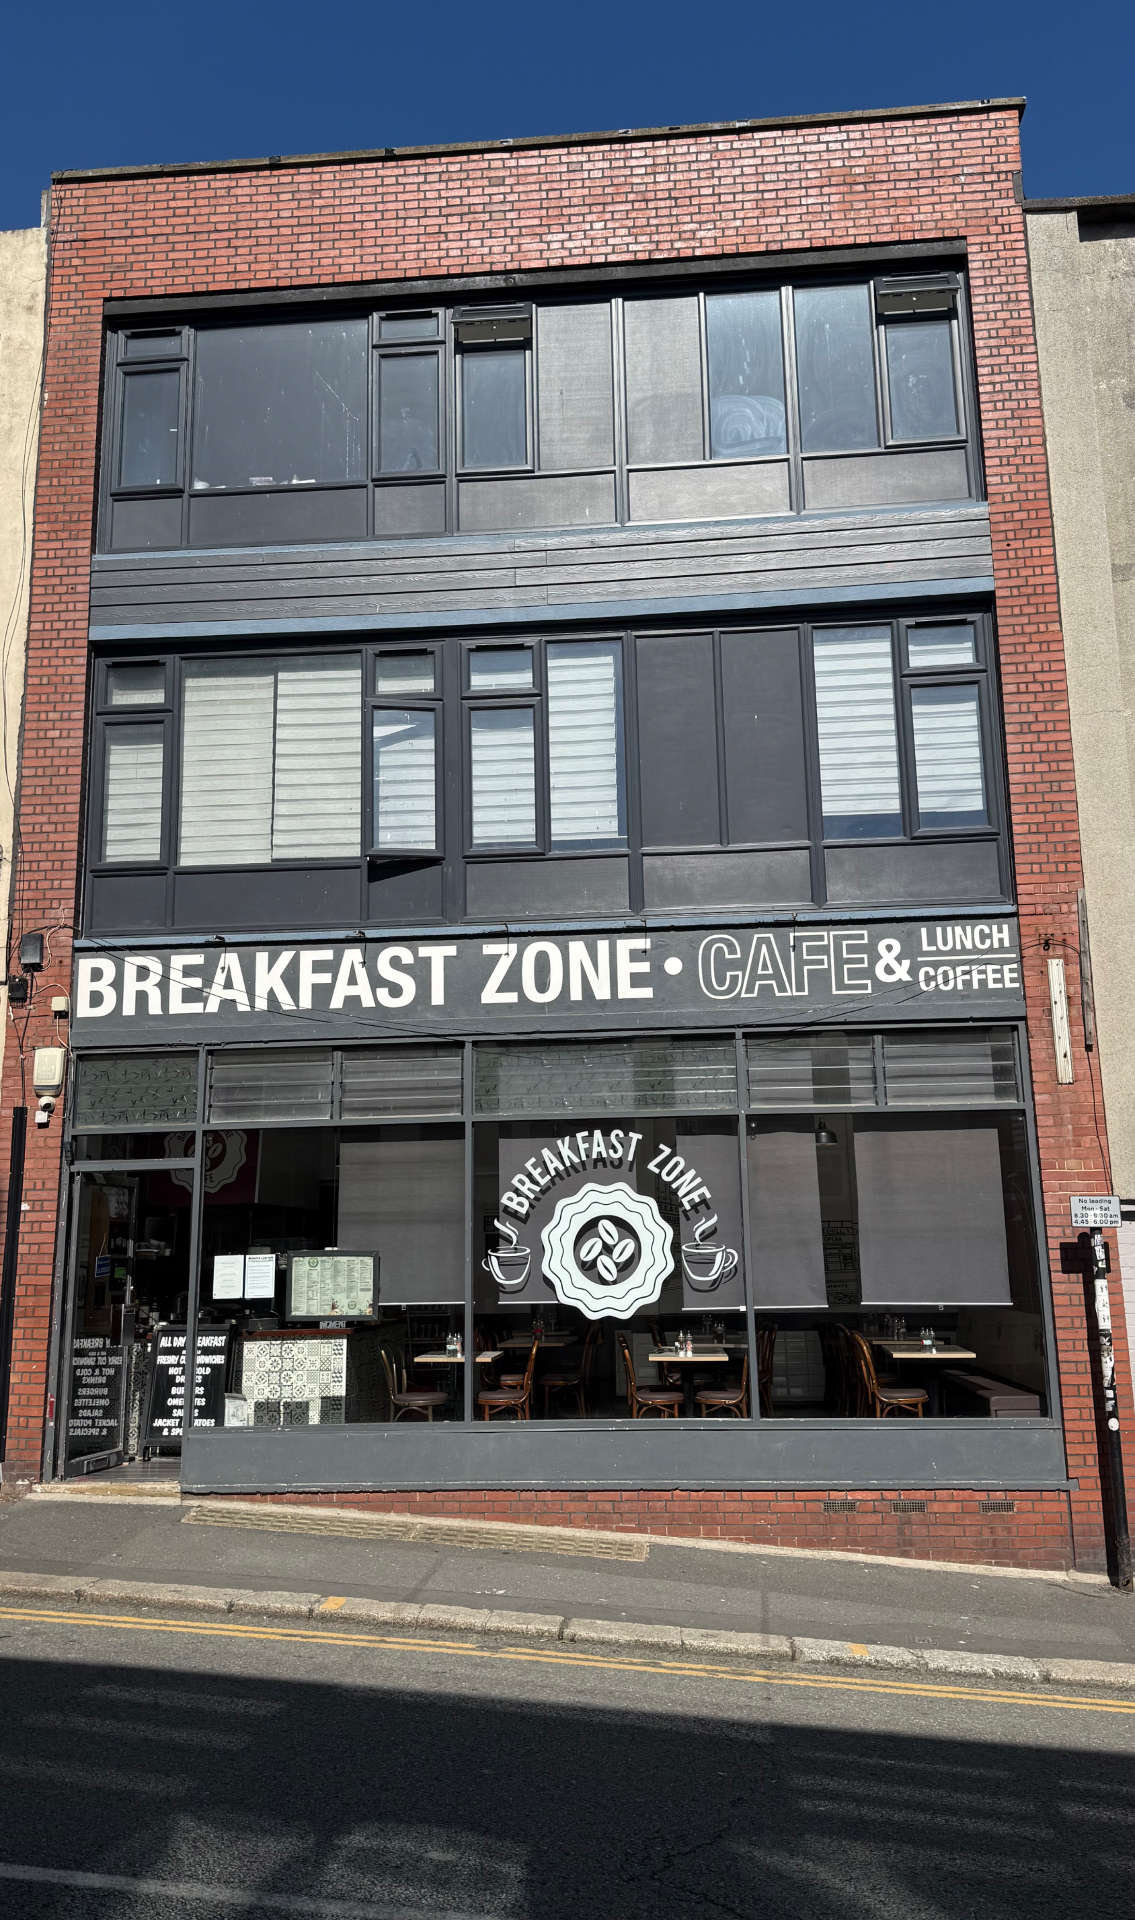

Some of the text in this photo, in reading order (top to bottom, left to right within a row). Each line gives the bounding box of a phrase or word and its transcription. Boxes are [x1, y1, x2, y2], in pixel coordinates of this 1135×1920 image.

[920, 924, 1010, 951] LUNCH
[76, 930, 913, 1018] BREAKFAST ZONE CAFE &
[918, 963, 1020, 991] COFFEE
[500, 1129, 712, 1215] BREAKFAST ZONE
[160, 1336, 172, 1347] ALL
[173, 1336, 187, 1347] DAY
[157, 1355, 179, 1365] FRESHLY
[196, 1355, 225, 1365] NDWICHES
[168, 1366, 183, 1375] HOT
[152, 1418, 180, 1427] JACKET
